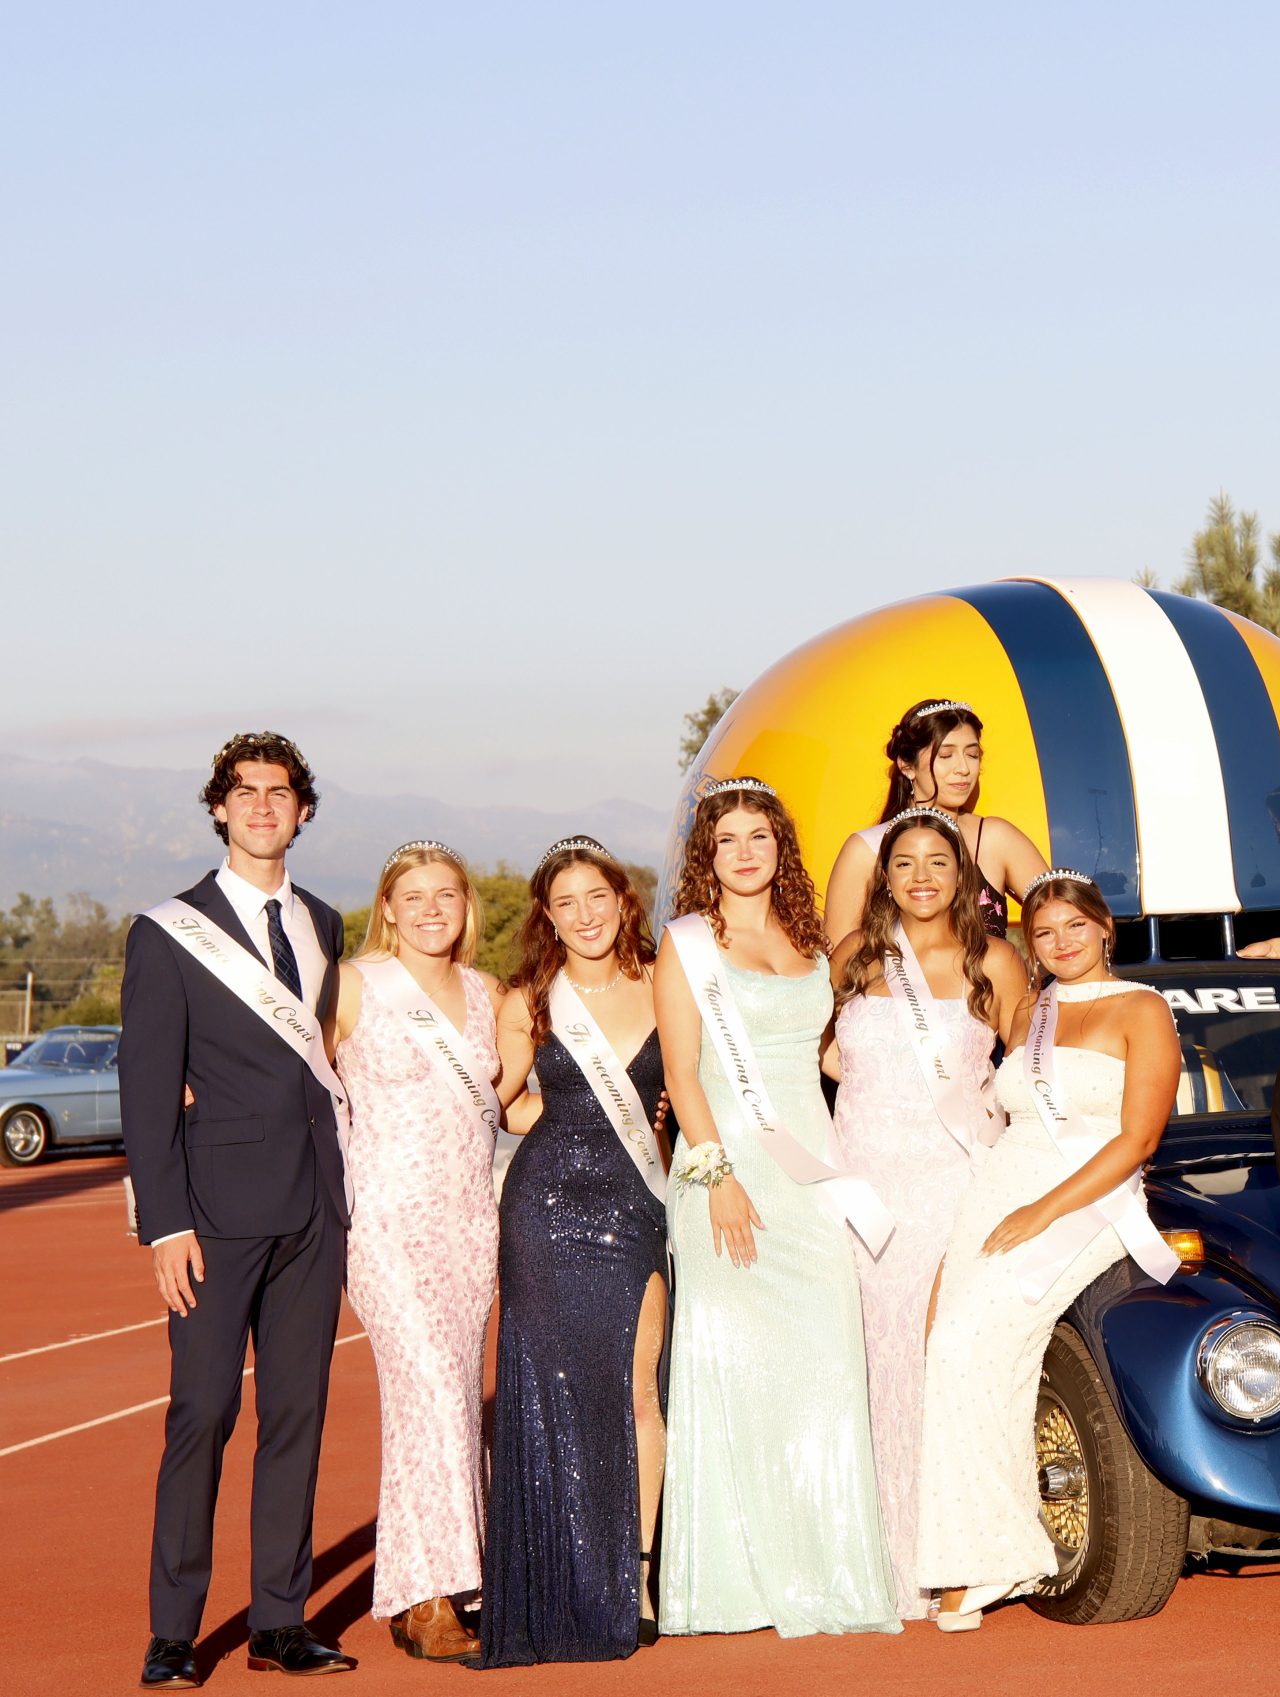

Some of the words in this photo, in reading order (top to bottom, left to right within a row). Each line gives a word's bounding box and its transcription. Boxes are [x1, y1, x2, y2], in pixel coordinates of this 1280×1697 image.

[272, 1006, 316, 1043] Court
[701, 973, 749, 1084] Homecoming
[742, 1088, 775, 1133] Court
[627, 1129, 655, 1167] Court
